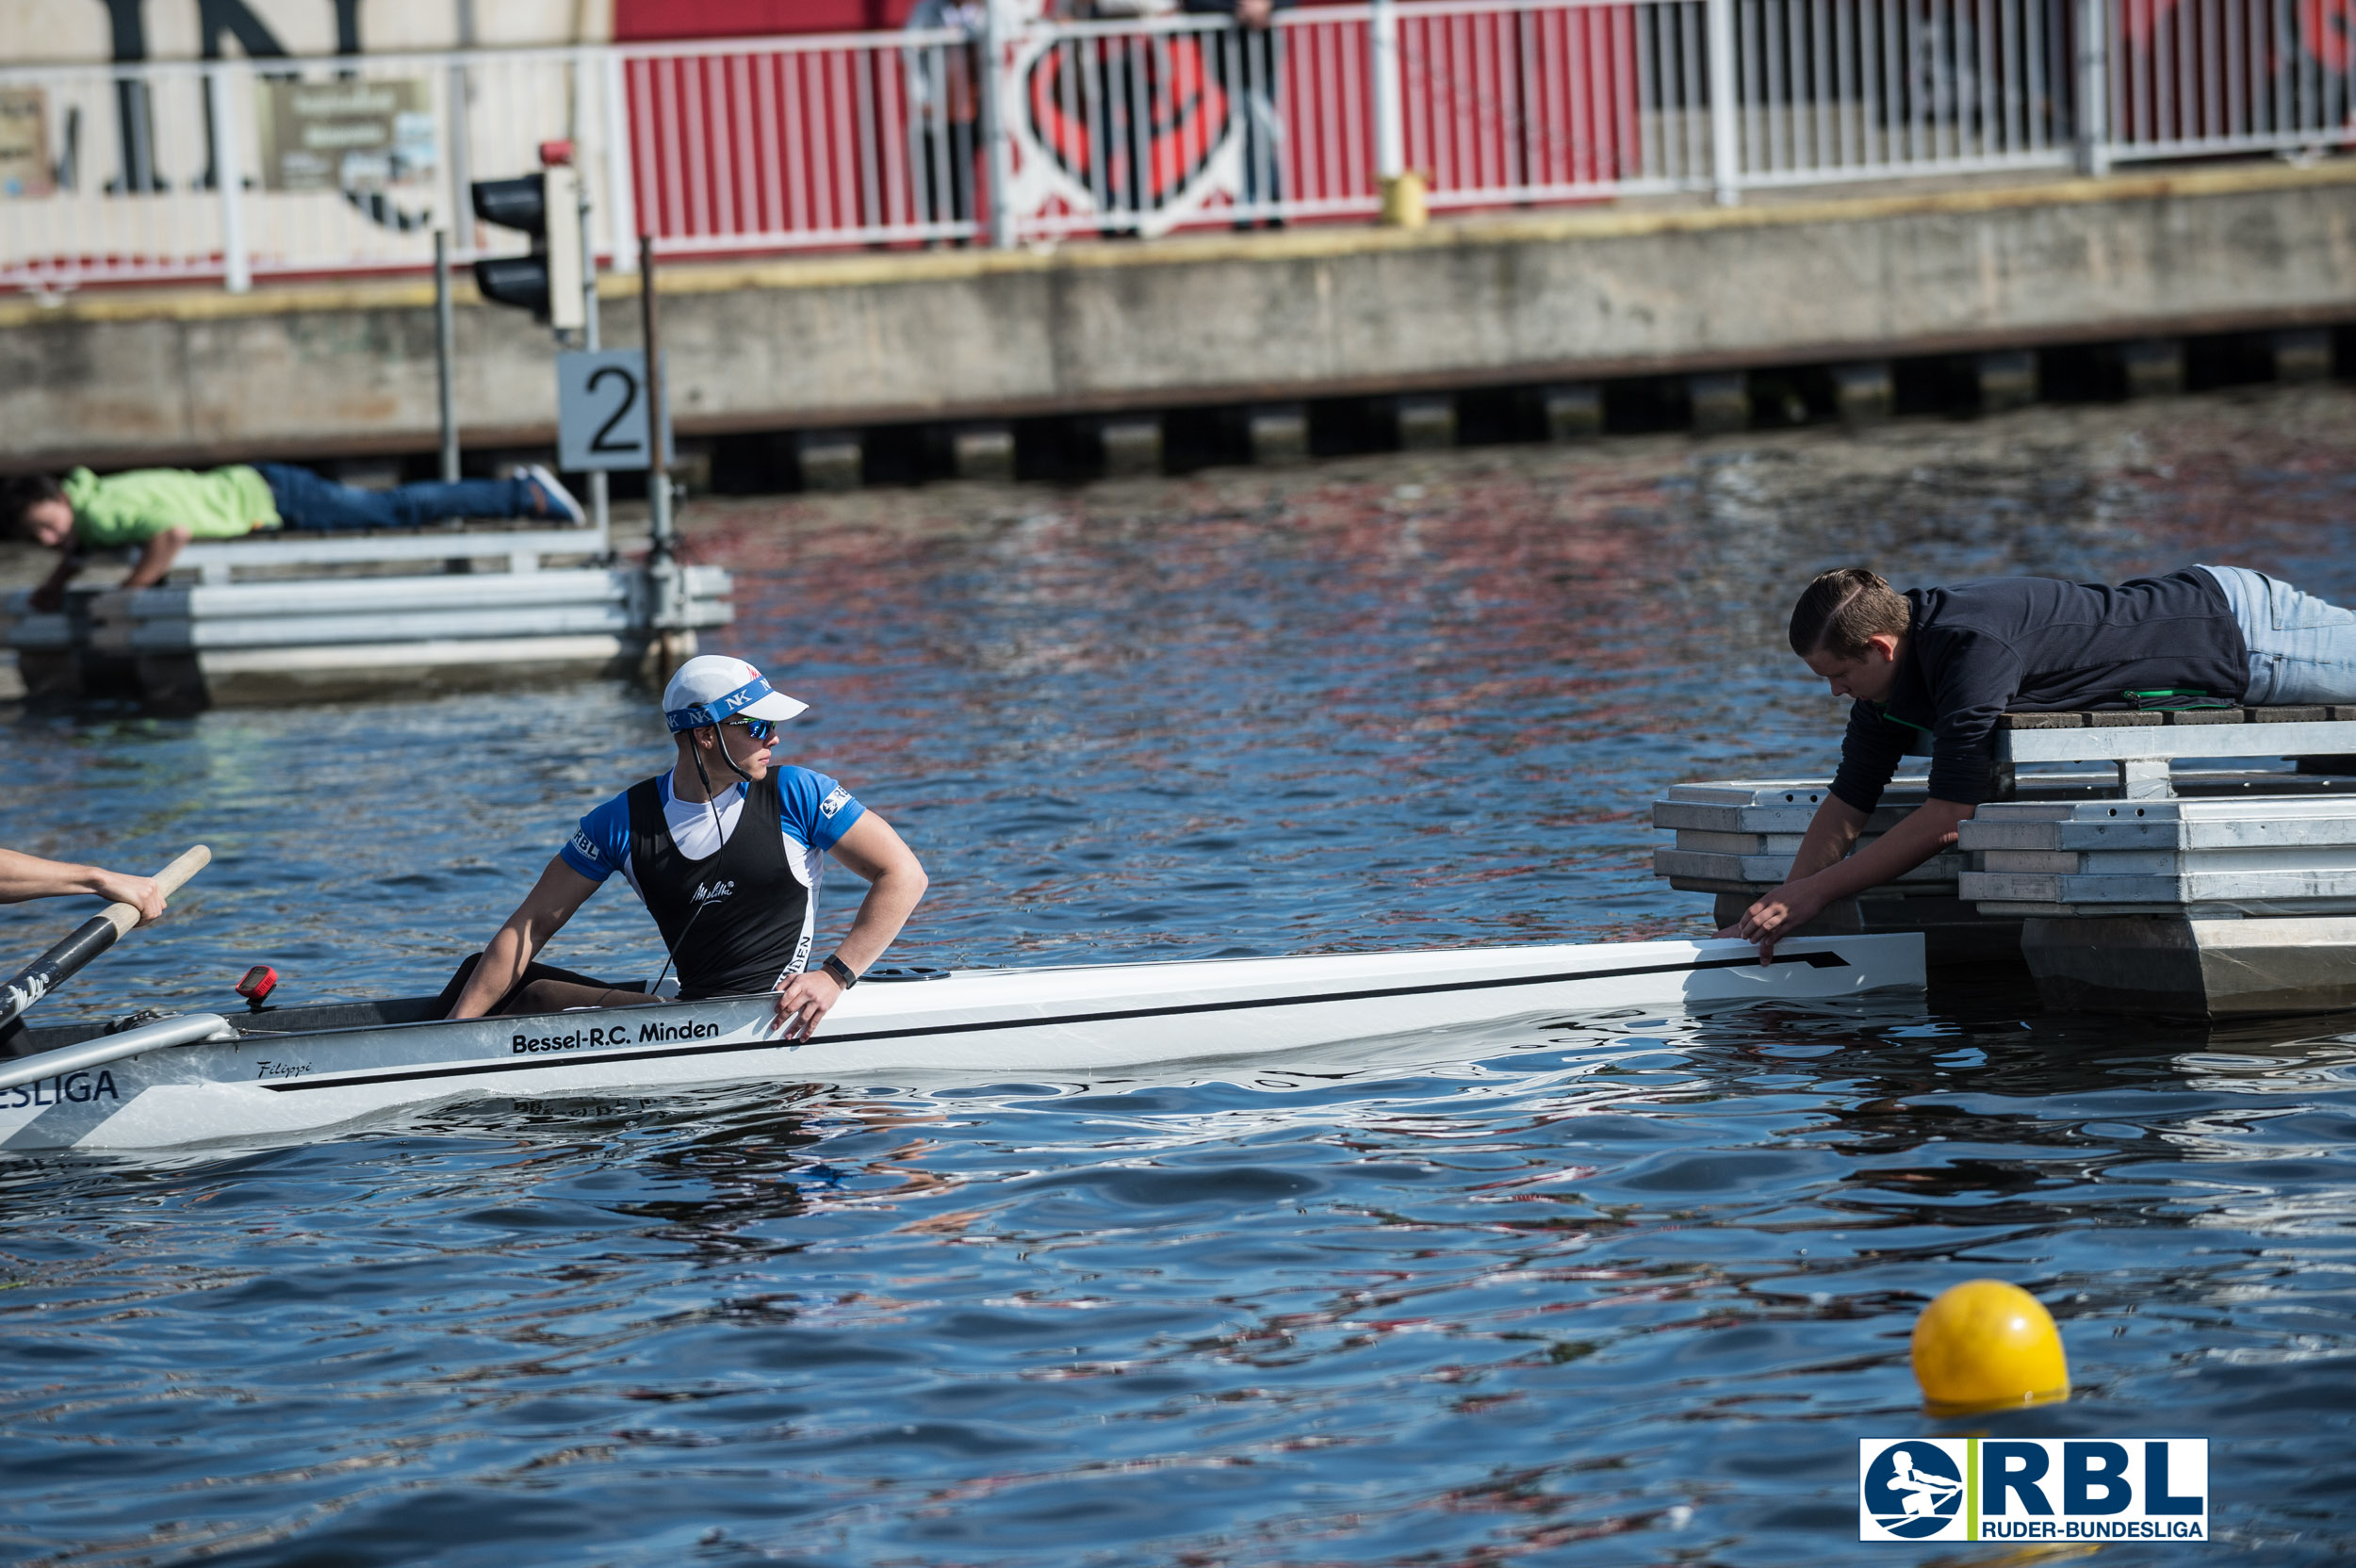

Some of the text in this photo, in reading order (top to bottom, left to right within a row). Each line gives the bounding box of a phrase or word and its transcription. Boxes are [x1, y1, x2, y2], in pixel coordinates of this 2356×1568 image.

[586, 366, 641, 453] 2
[725, 689, 753, 711] NK
[689, 709, 712, 725] NK
[574, 829, 597, 858] RBL
[512, 1020, 719, 1054] Bessel-R.C. Minden
[256, 1060, 312, 1079] Filippi
